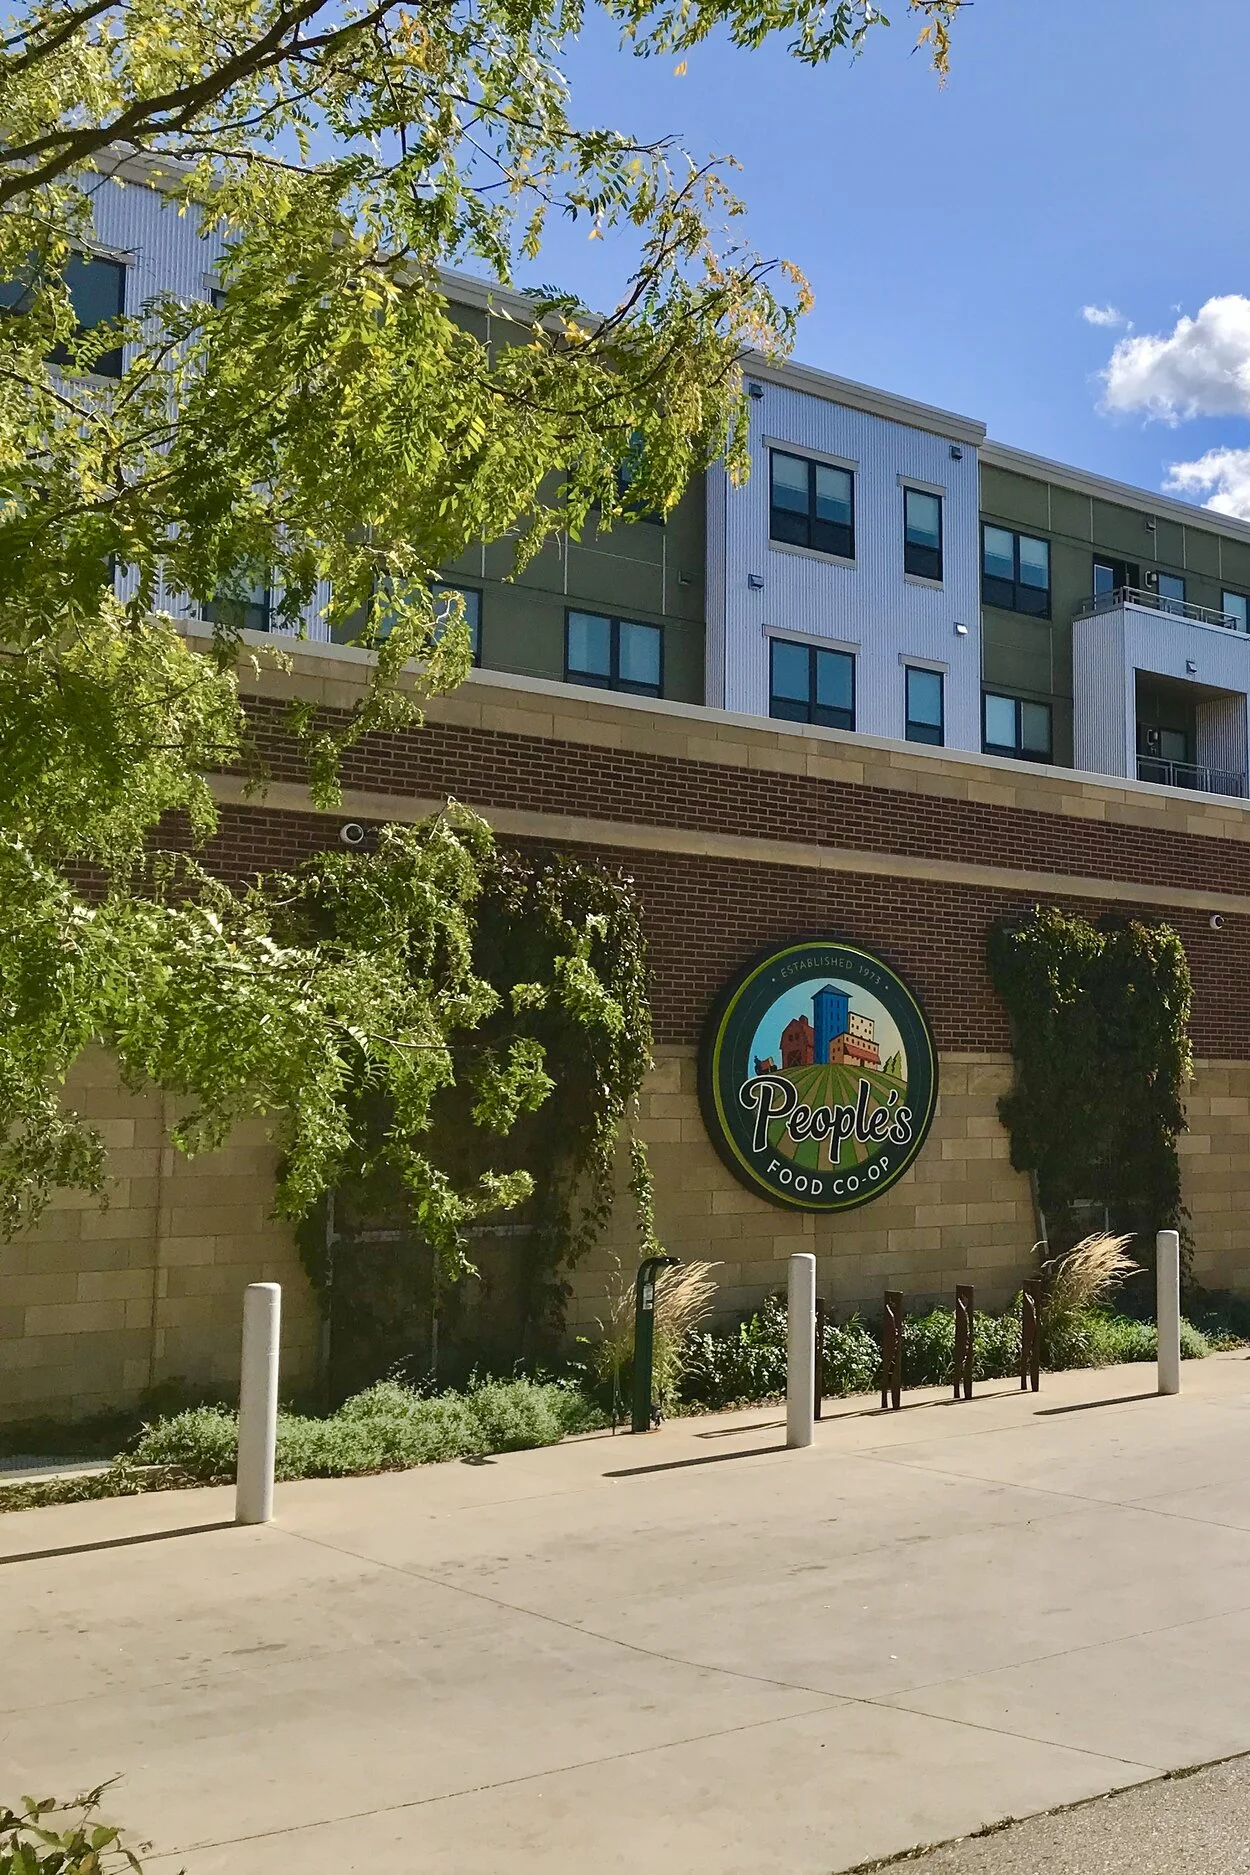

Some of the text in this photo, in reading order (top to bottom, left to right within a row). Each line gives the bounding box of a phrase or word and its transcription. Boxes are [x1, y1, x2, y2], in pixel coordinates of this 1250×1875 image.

[781, 957, 881, 985] ESTABLISHED 1973
[738, 1075, 913, 1164] People's
[767, 1156, 890, 1195] FOOD CO-OP
